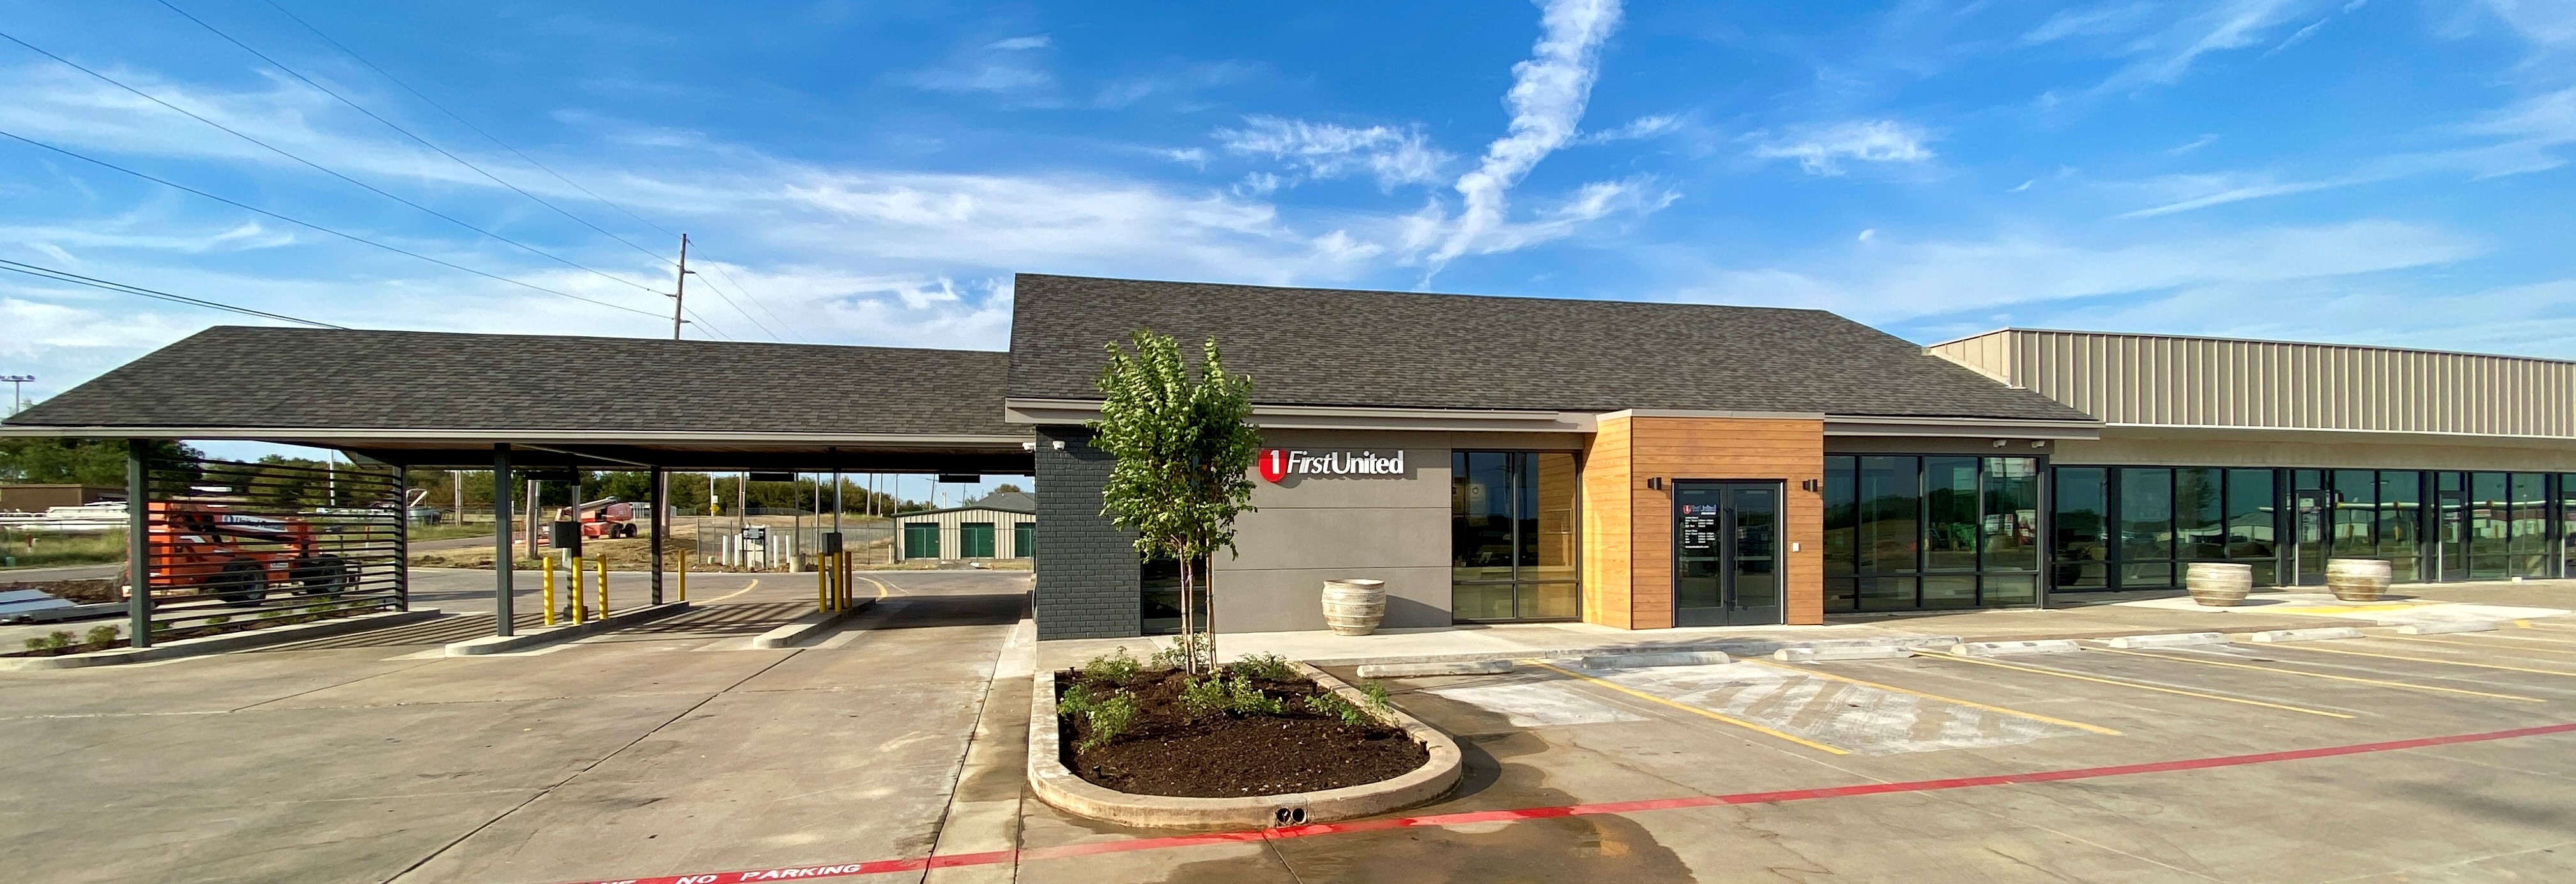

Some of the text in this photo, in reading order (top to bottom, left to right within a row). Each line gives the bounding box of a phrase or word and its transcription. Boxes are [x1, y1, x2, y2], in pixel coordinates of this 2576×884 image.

[1270, 450, 1404, 474] 1 FirstUnited
[675, 864, 861, 884] NO PARKING
